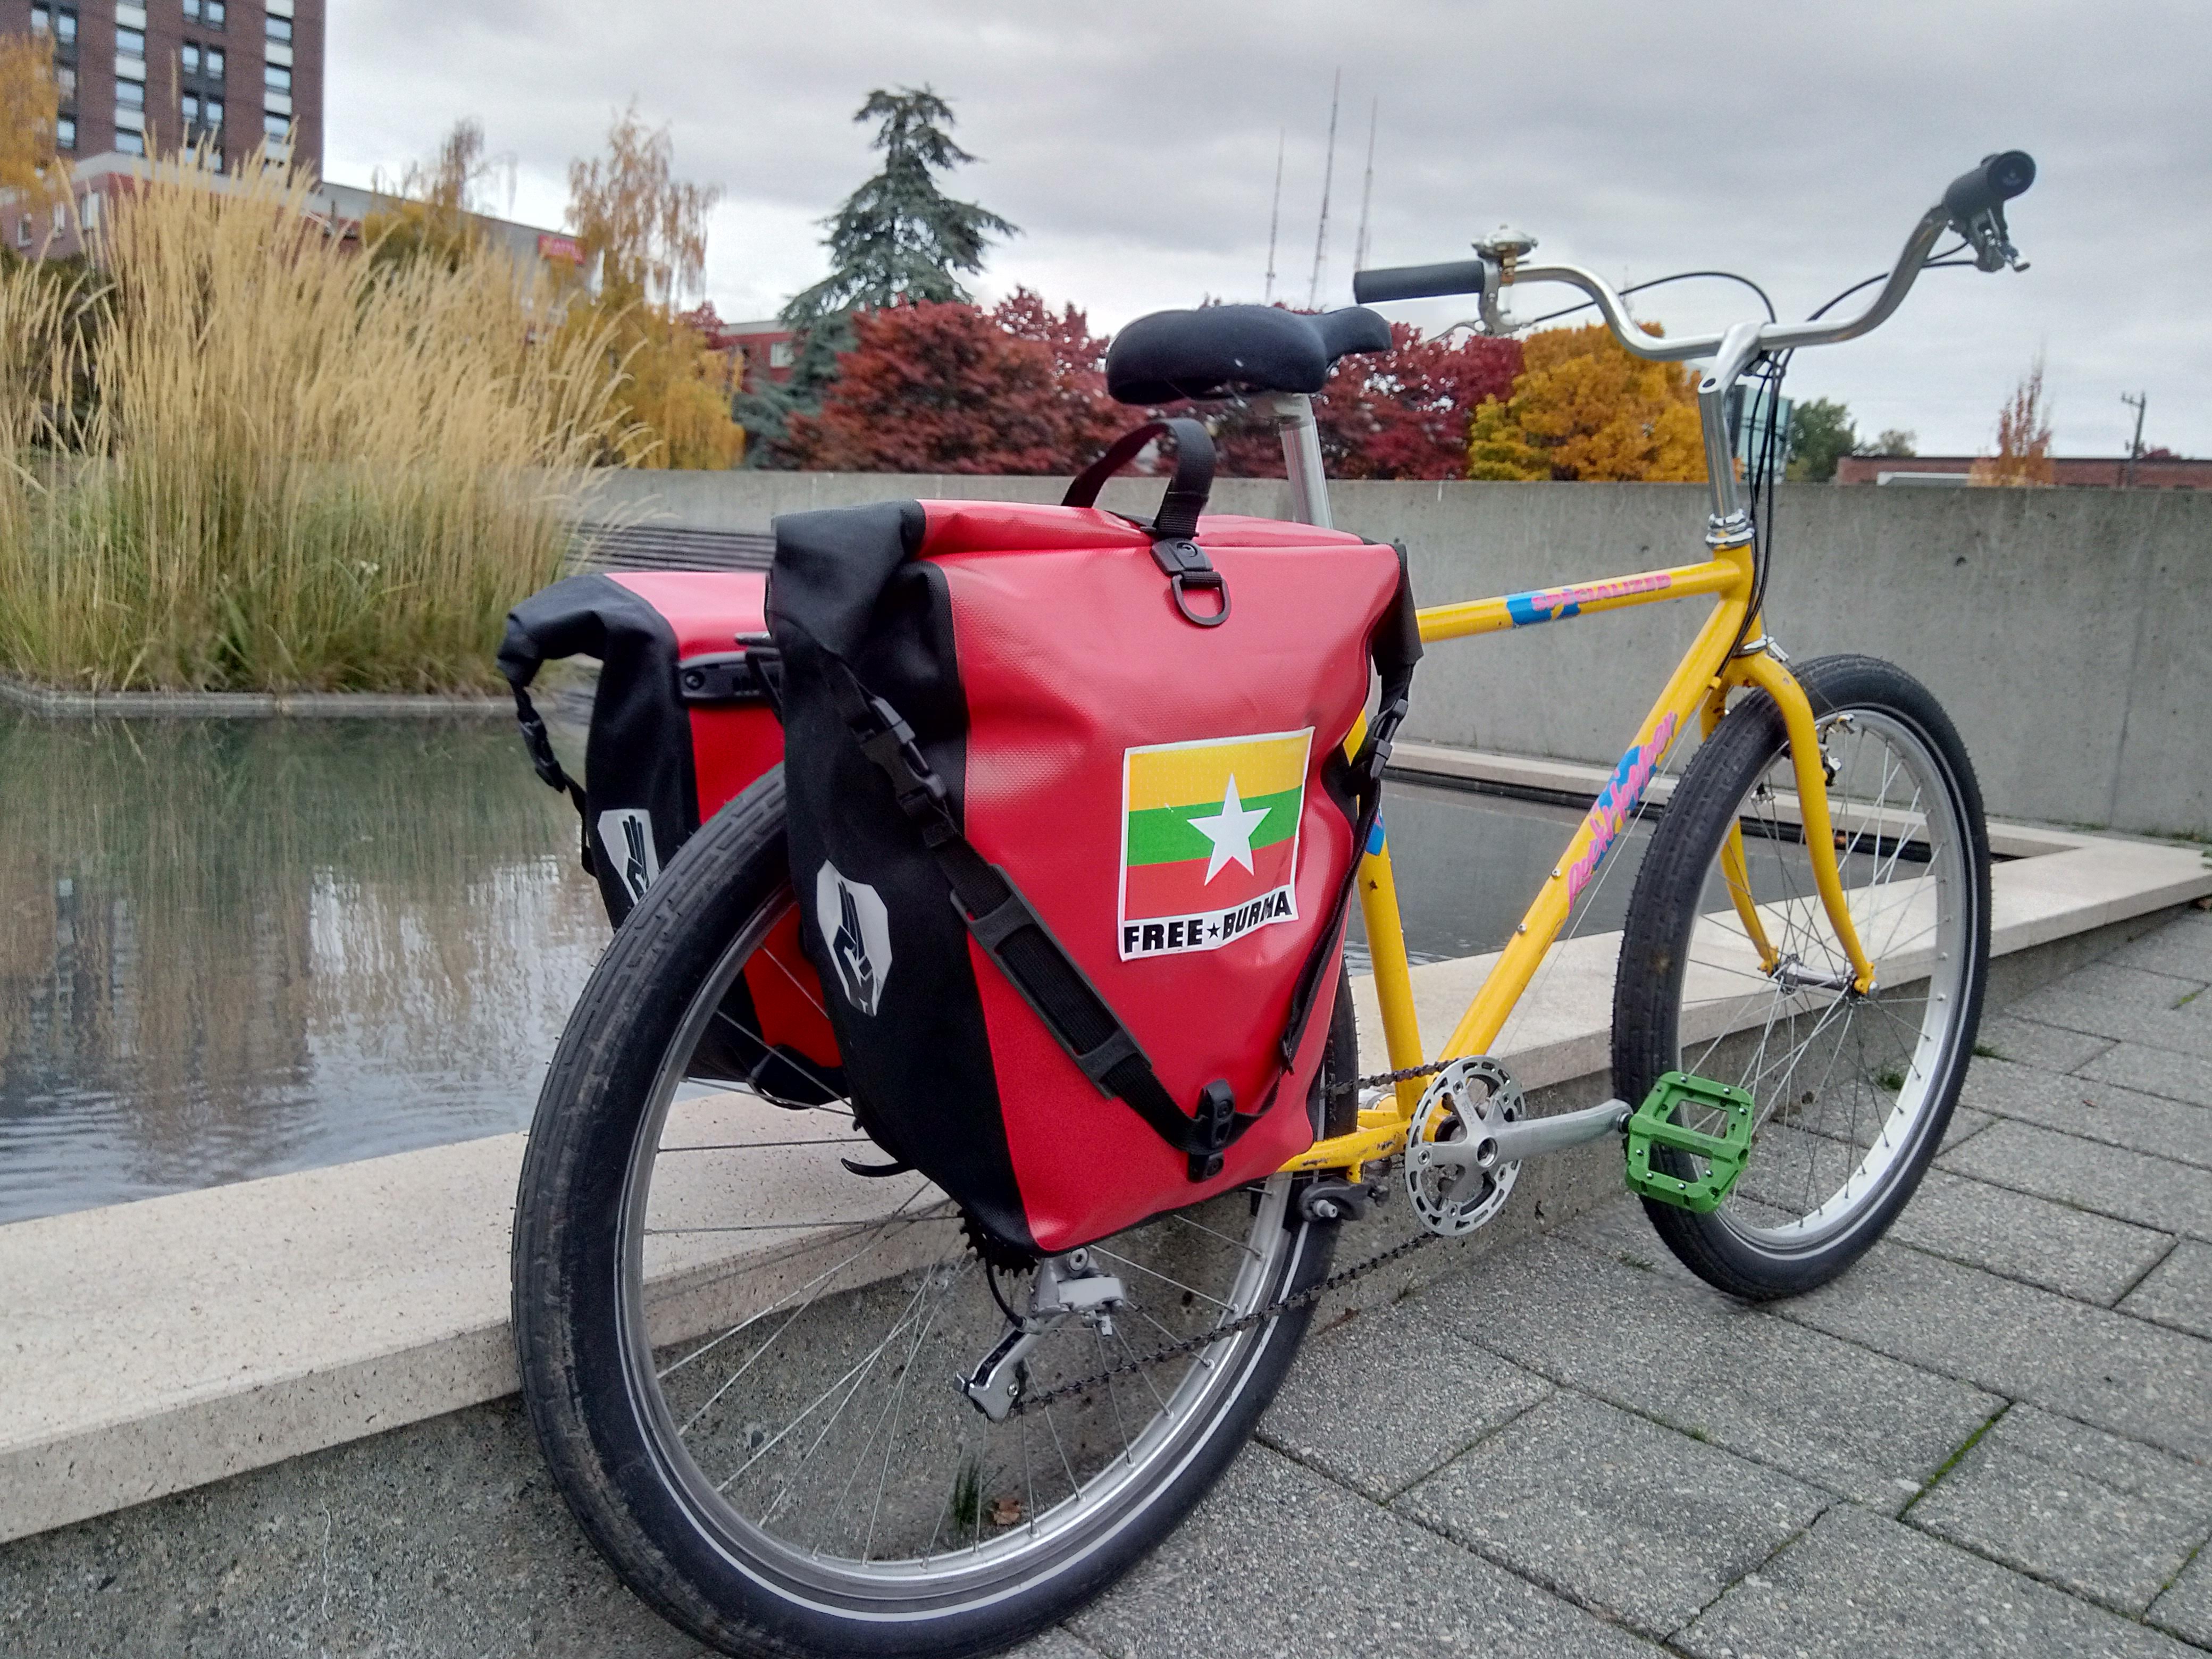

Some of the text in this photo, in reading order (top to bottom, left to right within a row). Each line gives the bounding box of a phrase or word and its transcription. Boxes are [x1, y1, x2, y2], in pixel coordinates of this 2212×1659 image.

[1531, 574, 1671, 611] SPECIALIZED
[1124, 891, 1292, 954] FREE BURMA
